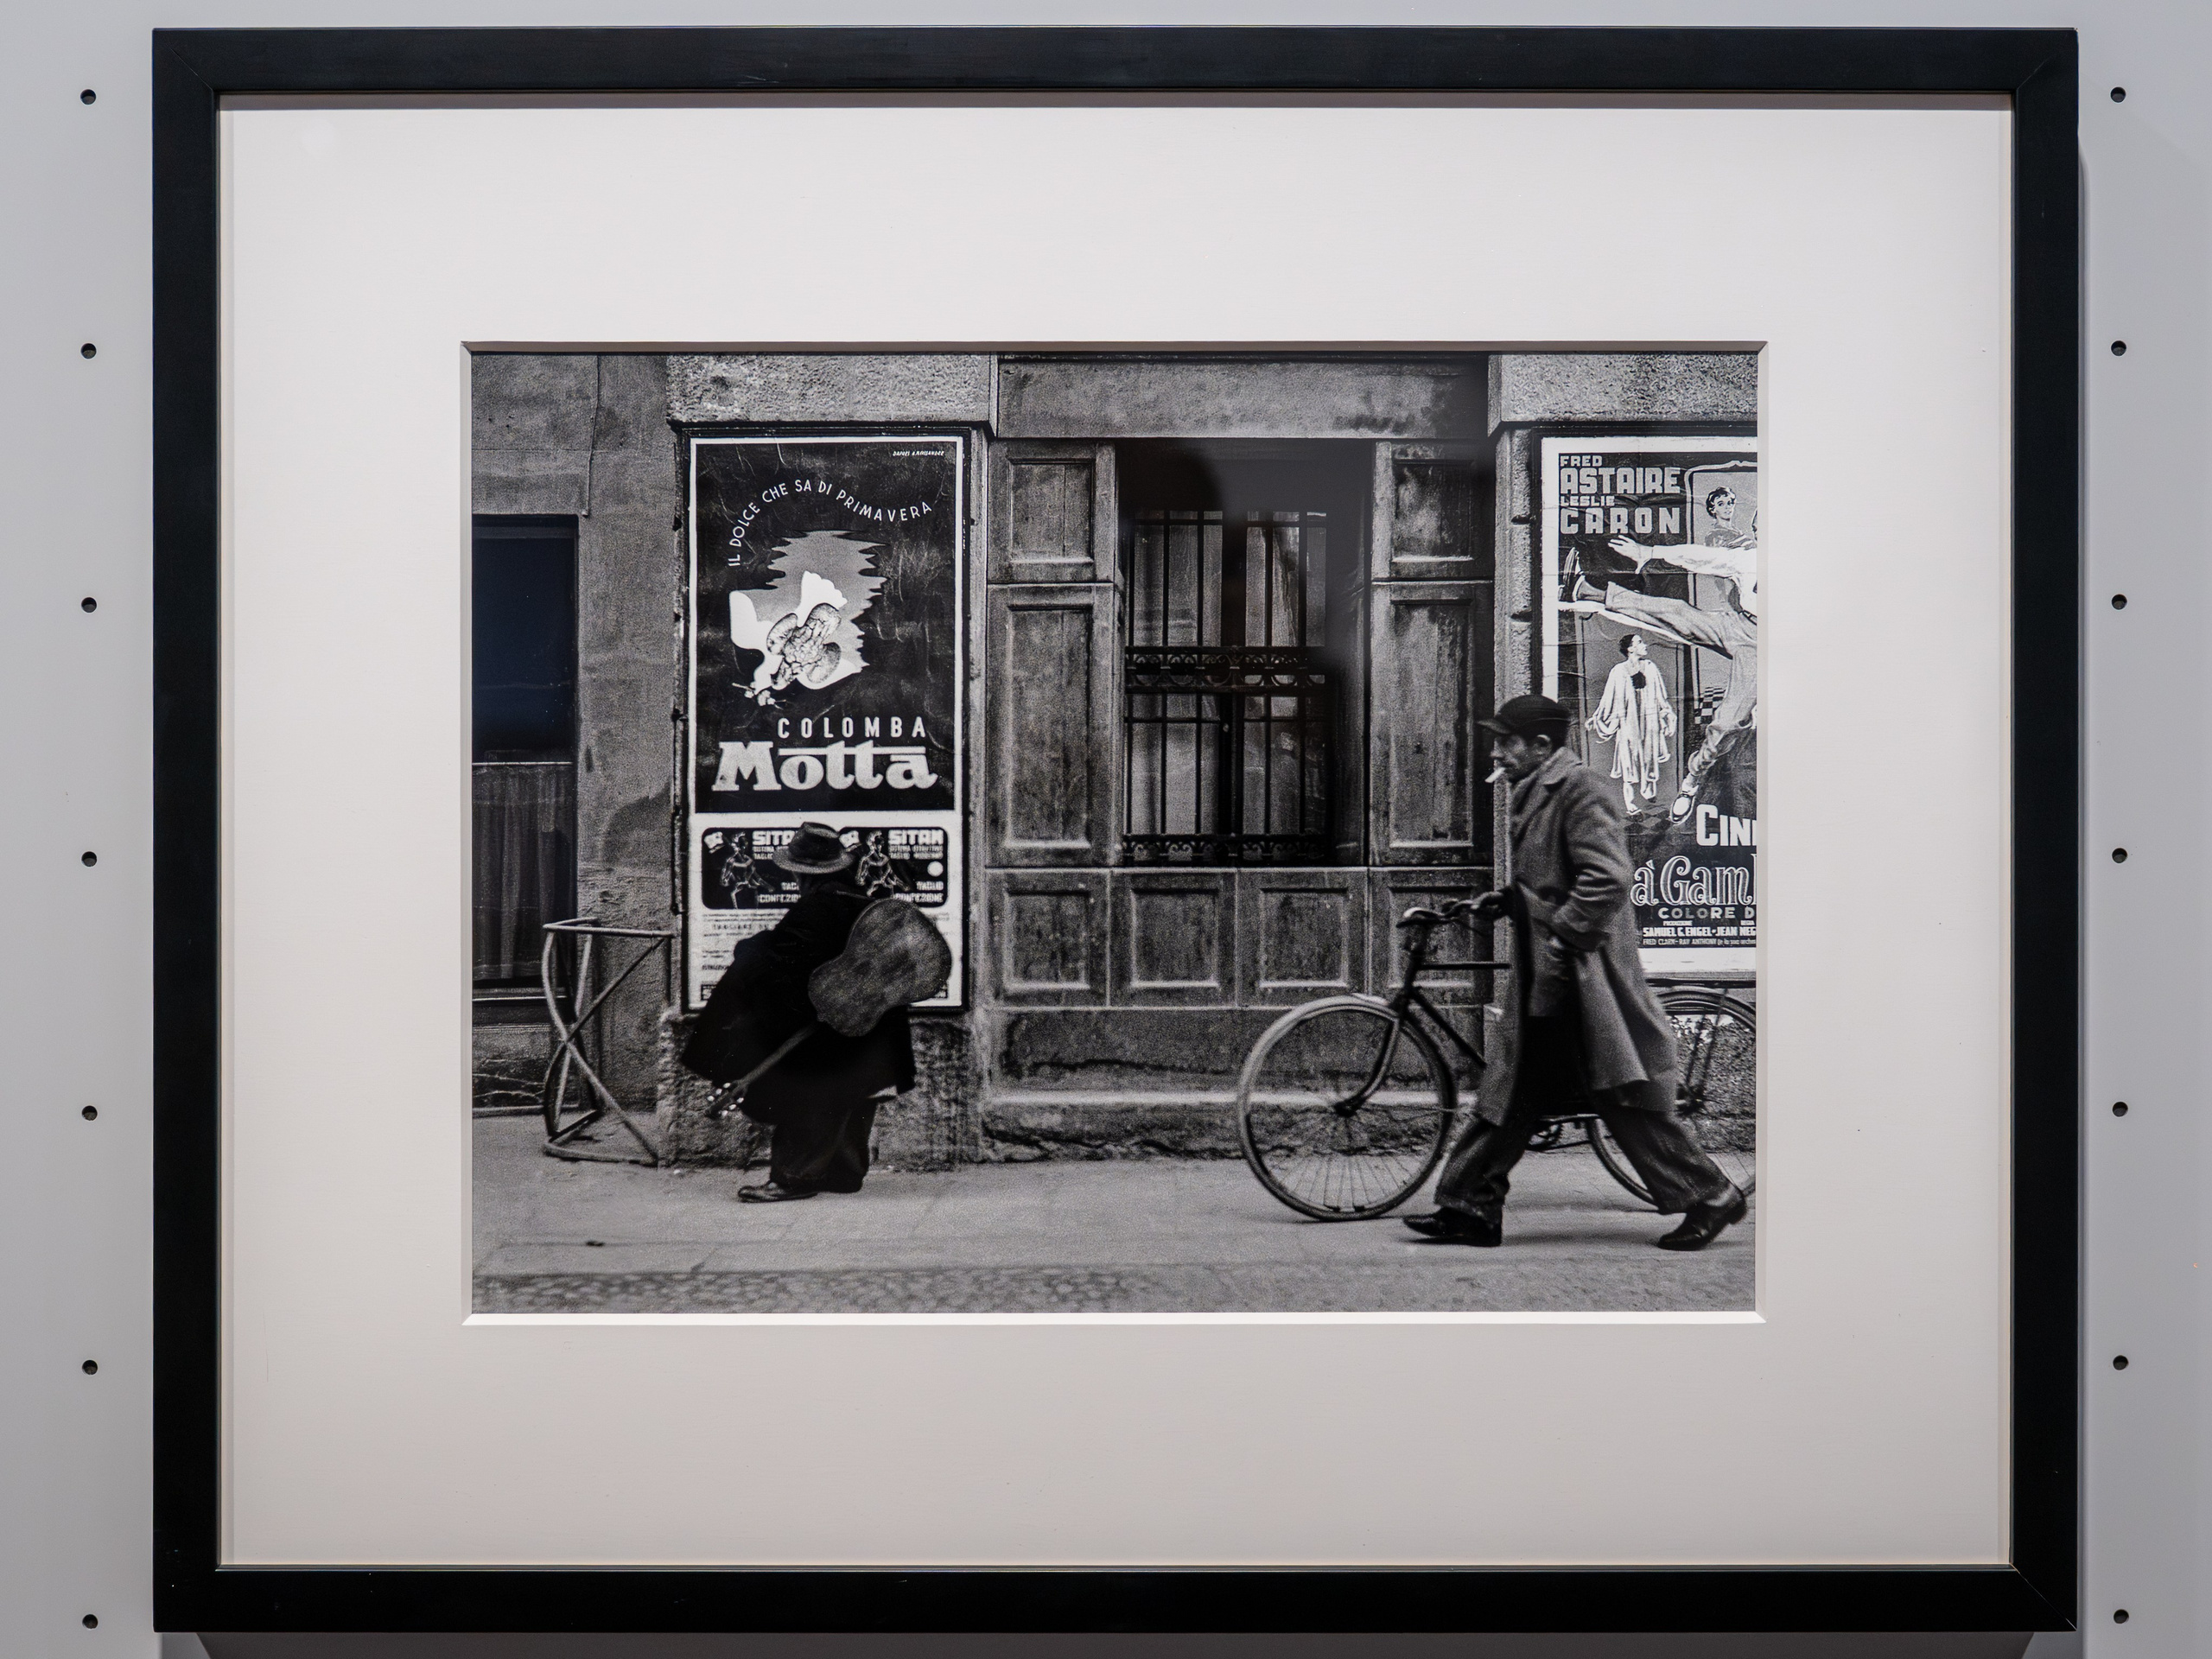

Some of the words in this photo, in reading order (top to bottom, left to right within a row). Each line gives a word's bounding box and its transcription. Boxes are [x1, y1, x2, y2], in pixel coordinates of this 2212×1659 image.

[1560, 455, 1603, 467] FRED
[795, 480, 811, 493] SA
[818, 480, 833, 495] DI
[1560, 467, 1681, 494] ASTAIRE
[762, 483, 788, 503] CHE
[1560, 495, 1615, 506] LESLIE
[836, 489, 932, 522] PRIMAVERA
[728, 502, 760, 547] DOLCE
[1560, 507, 1680, 534] CARON
[728, 554, 741, 567] IL
[778, 716, 926, 739] COLOMBA
[711, 740, 938, 791] Motta
[1696, 804, 1757, 846] CIN
[752, 830, 797, 846] SITA
[1660, 854, 1757, 906] Gam
[760, 893, 802, 904] CONFEZIO
[1658, 907, 1735, 918] COLORE
[1643, 927, 1676, 937] SAMUEL
